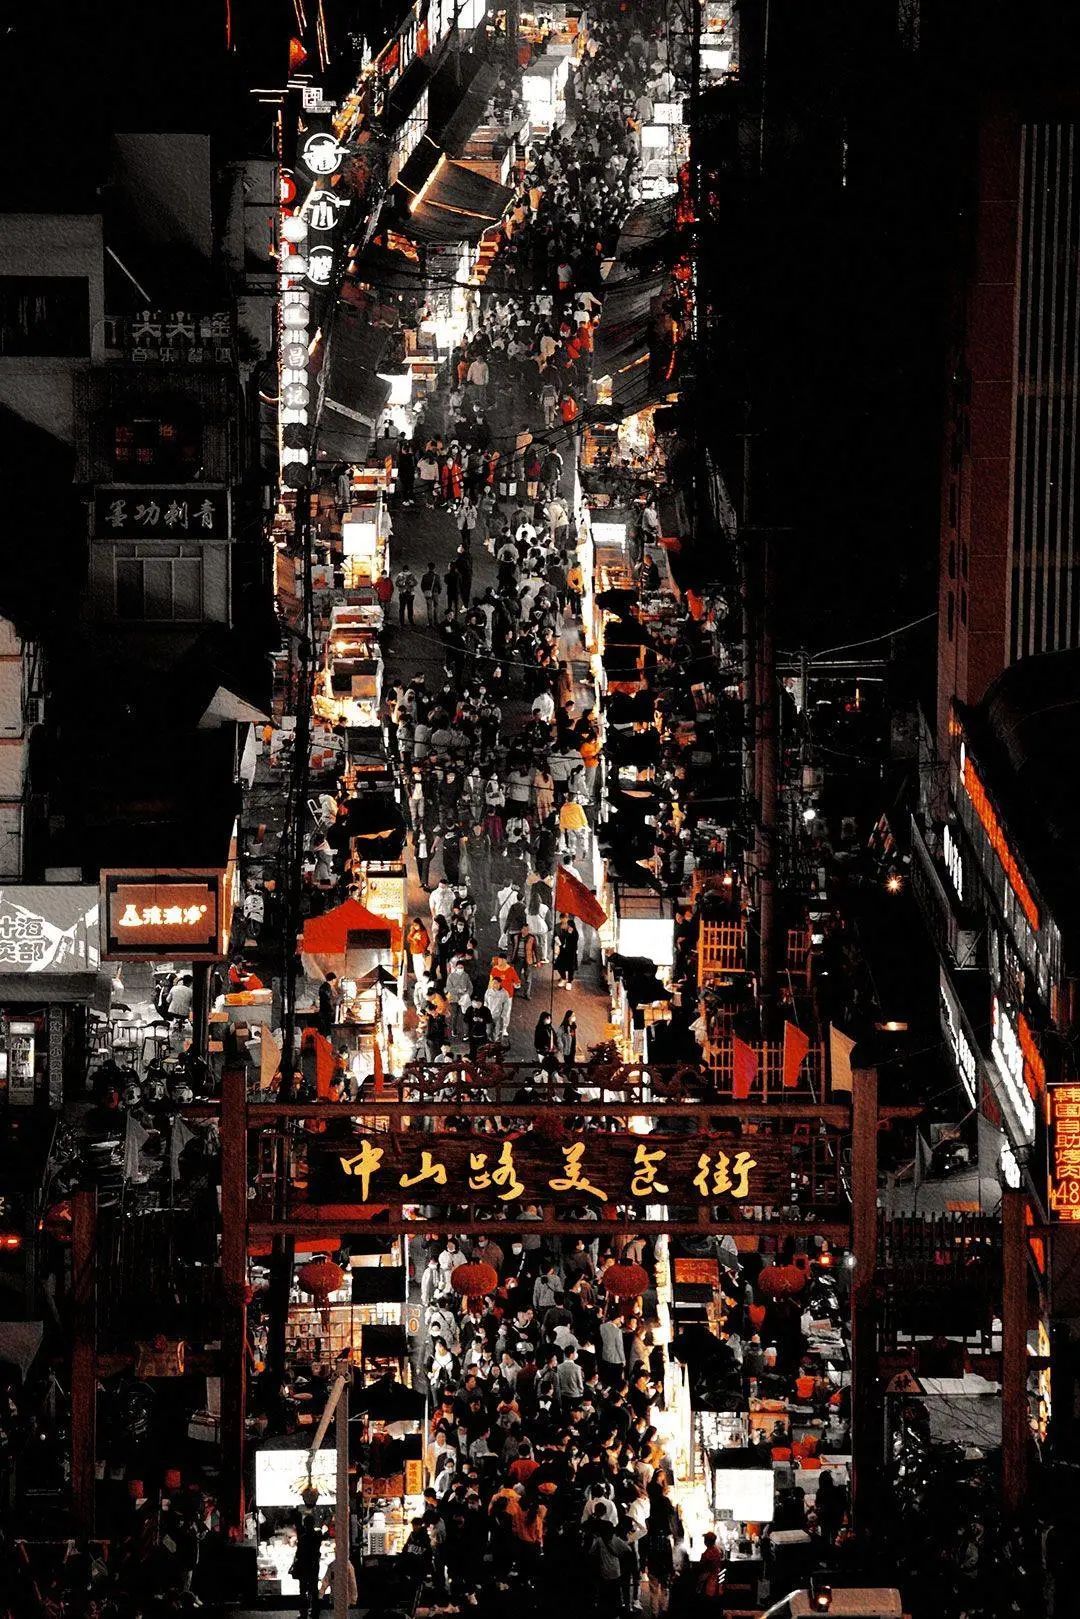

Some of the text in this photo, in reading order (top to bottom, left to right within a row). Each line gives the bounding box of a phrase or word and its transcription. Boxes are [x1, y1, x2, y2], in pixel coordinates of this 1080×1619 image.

[104, 498, 217, 530] 墨功刺青
[339, 1139, 757, 1202] 中山路美食街
